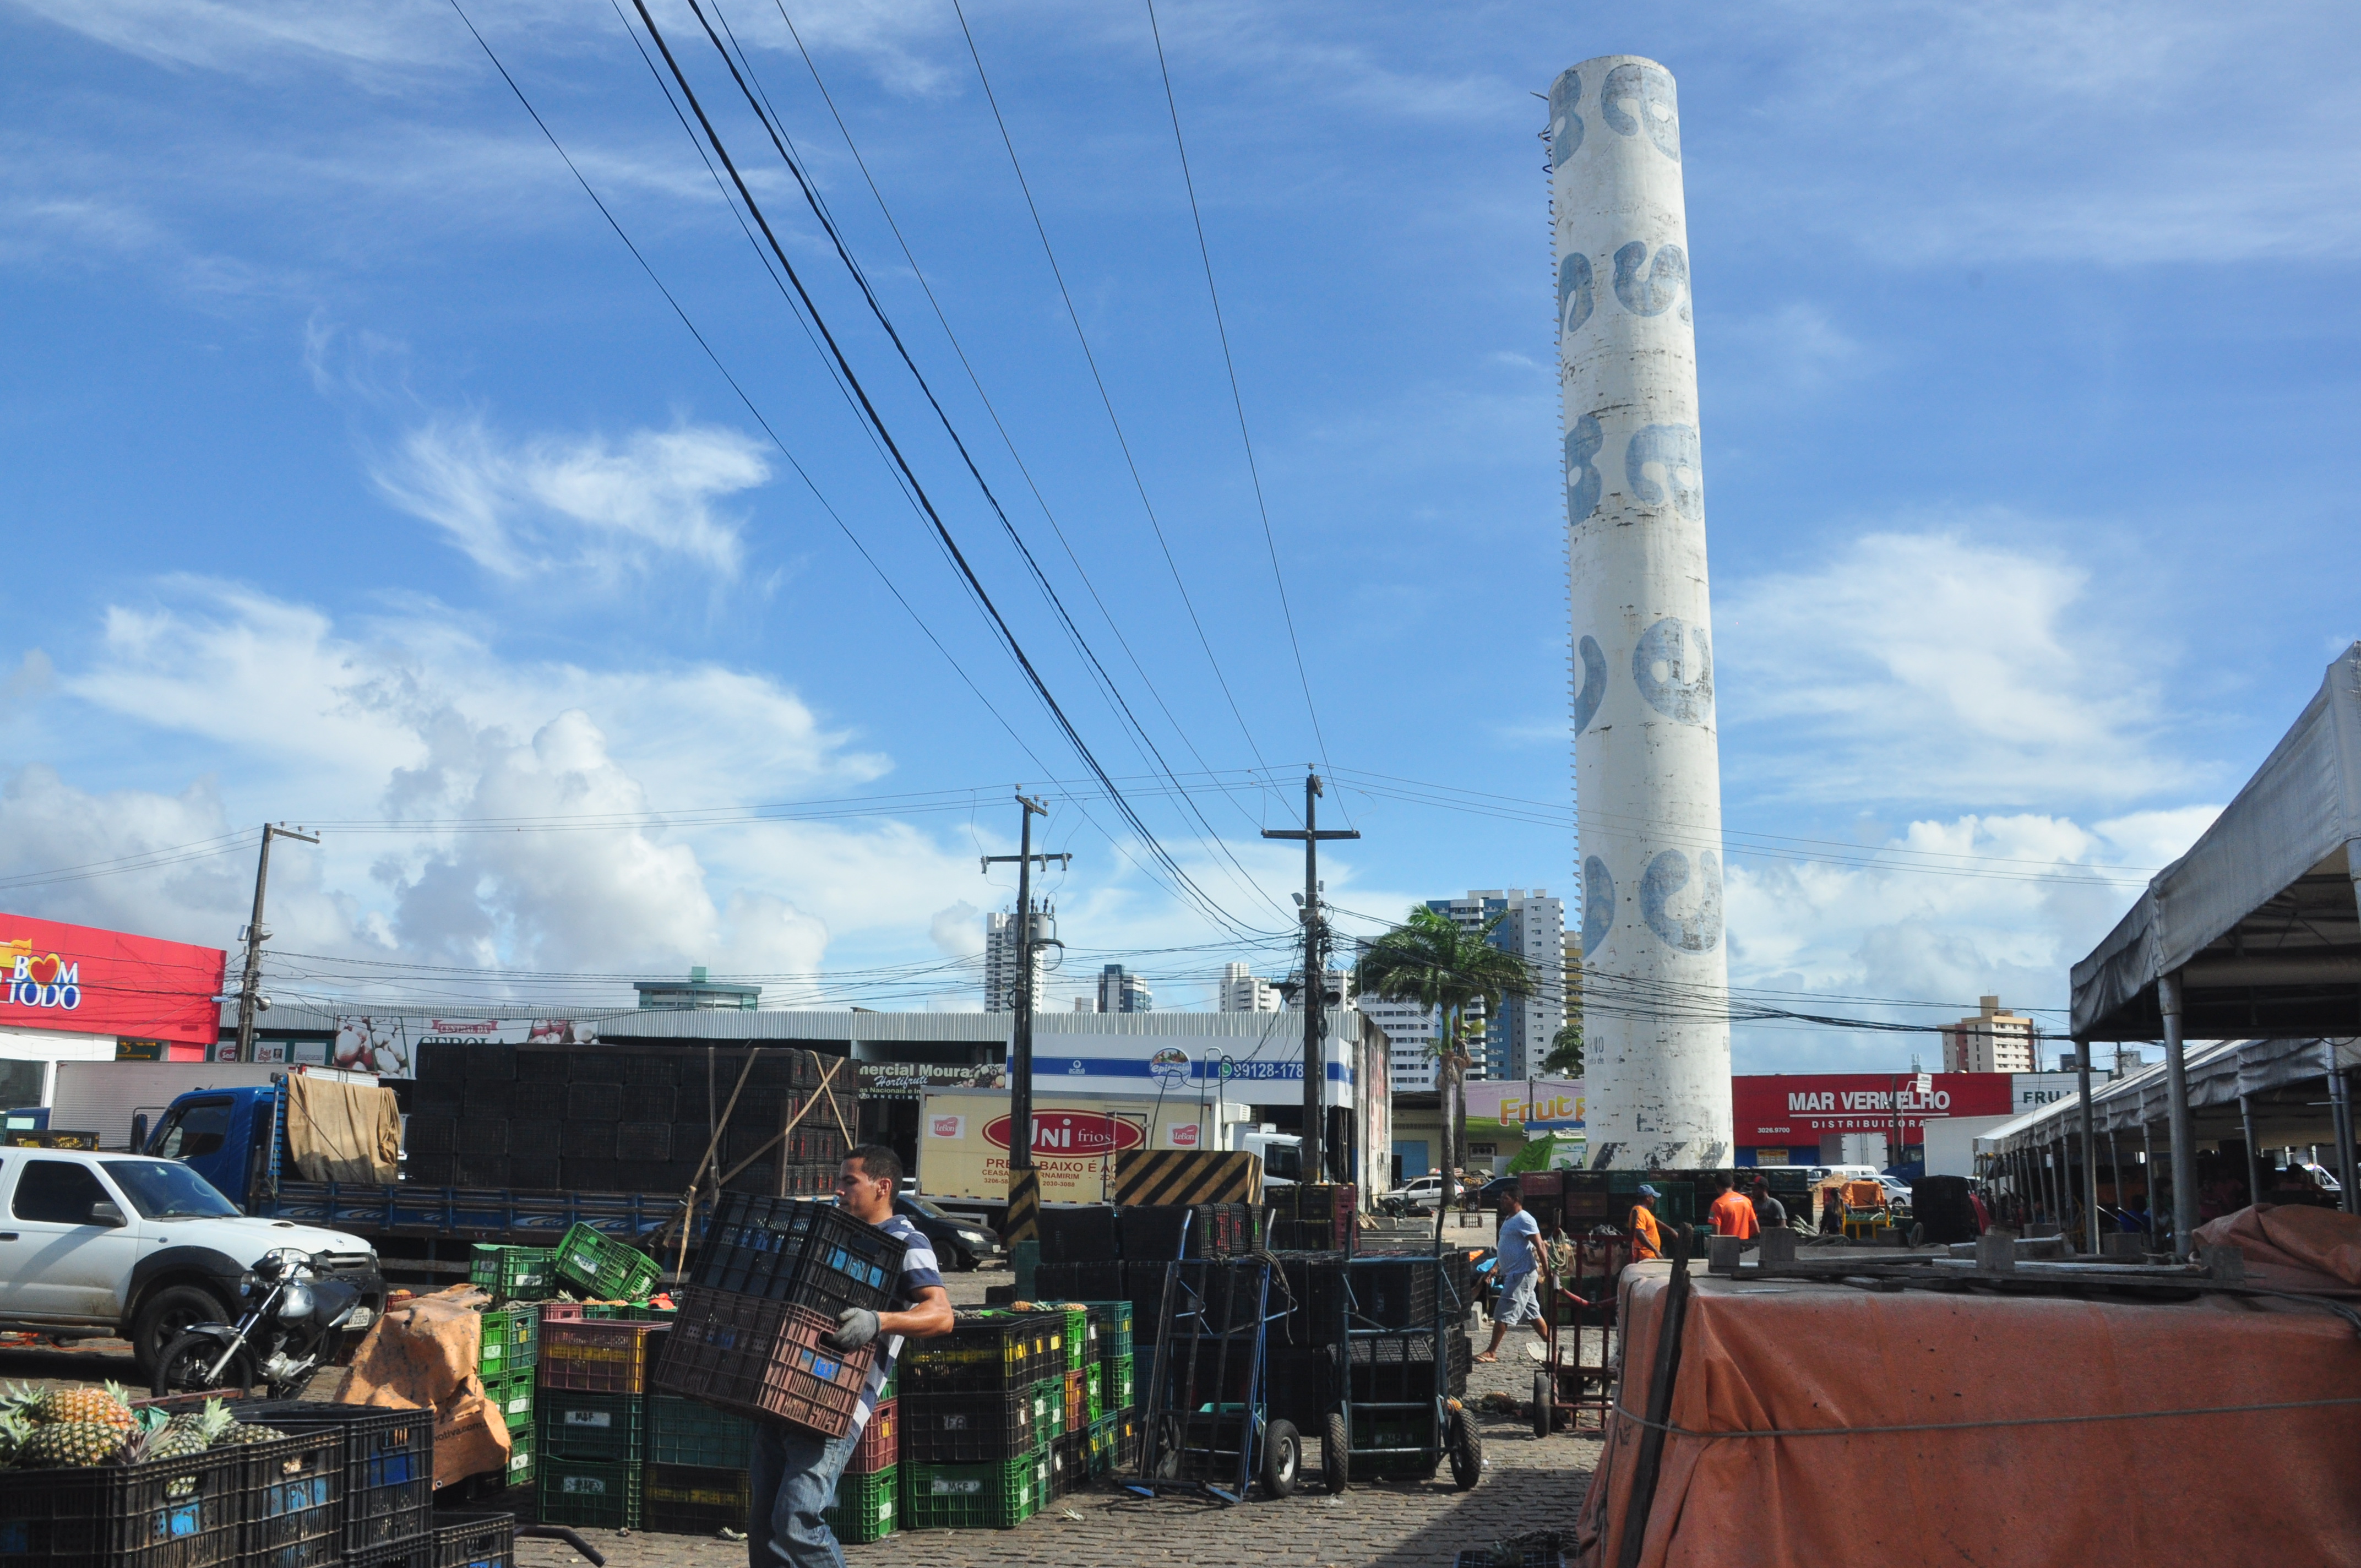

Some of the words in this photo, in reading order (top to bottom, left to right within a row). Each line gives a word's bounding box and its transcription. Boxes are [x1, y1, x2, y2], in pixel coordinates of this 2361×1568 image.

[6, 978, 81, 1010] TODO
[919, 1064, 973, 1078] Moura
[1233, 1063, 1304, 1078] 99128-178
[873, 1074, 929, 1090] Hortifruti
[869, 1086, 906, 1095] Nacionais
[2023, 1090, 2071, 1104] FRU
[1788, 1092, 1835, 1111] MAR
[1841, 1091, 1950, 1110] VERMELHO
[1811, 1119, 1925, 1129] DISTRIBUIDORA
[1040, 1161, 1084, 1172] BAIXO
[1088, 1159, 1097, 1173] É
